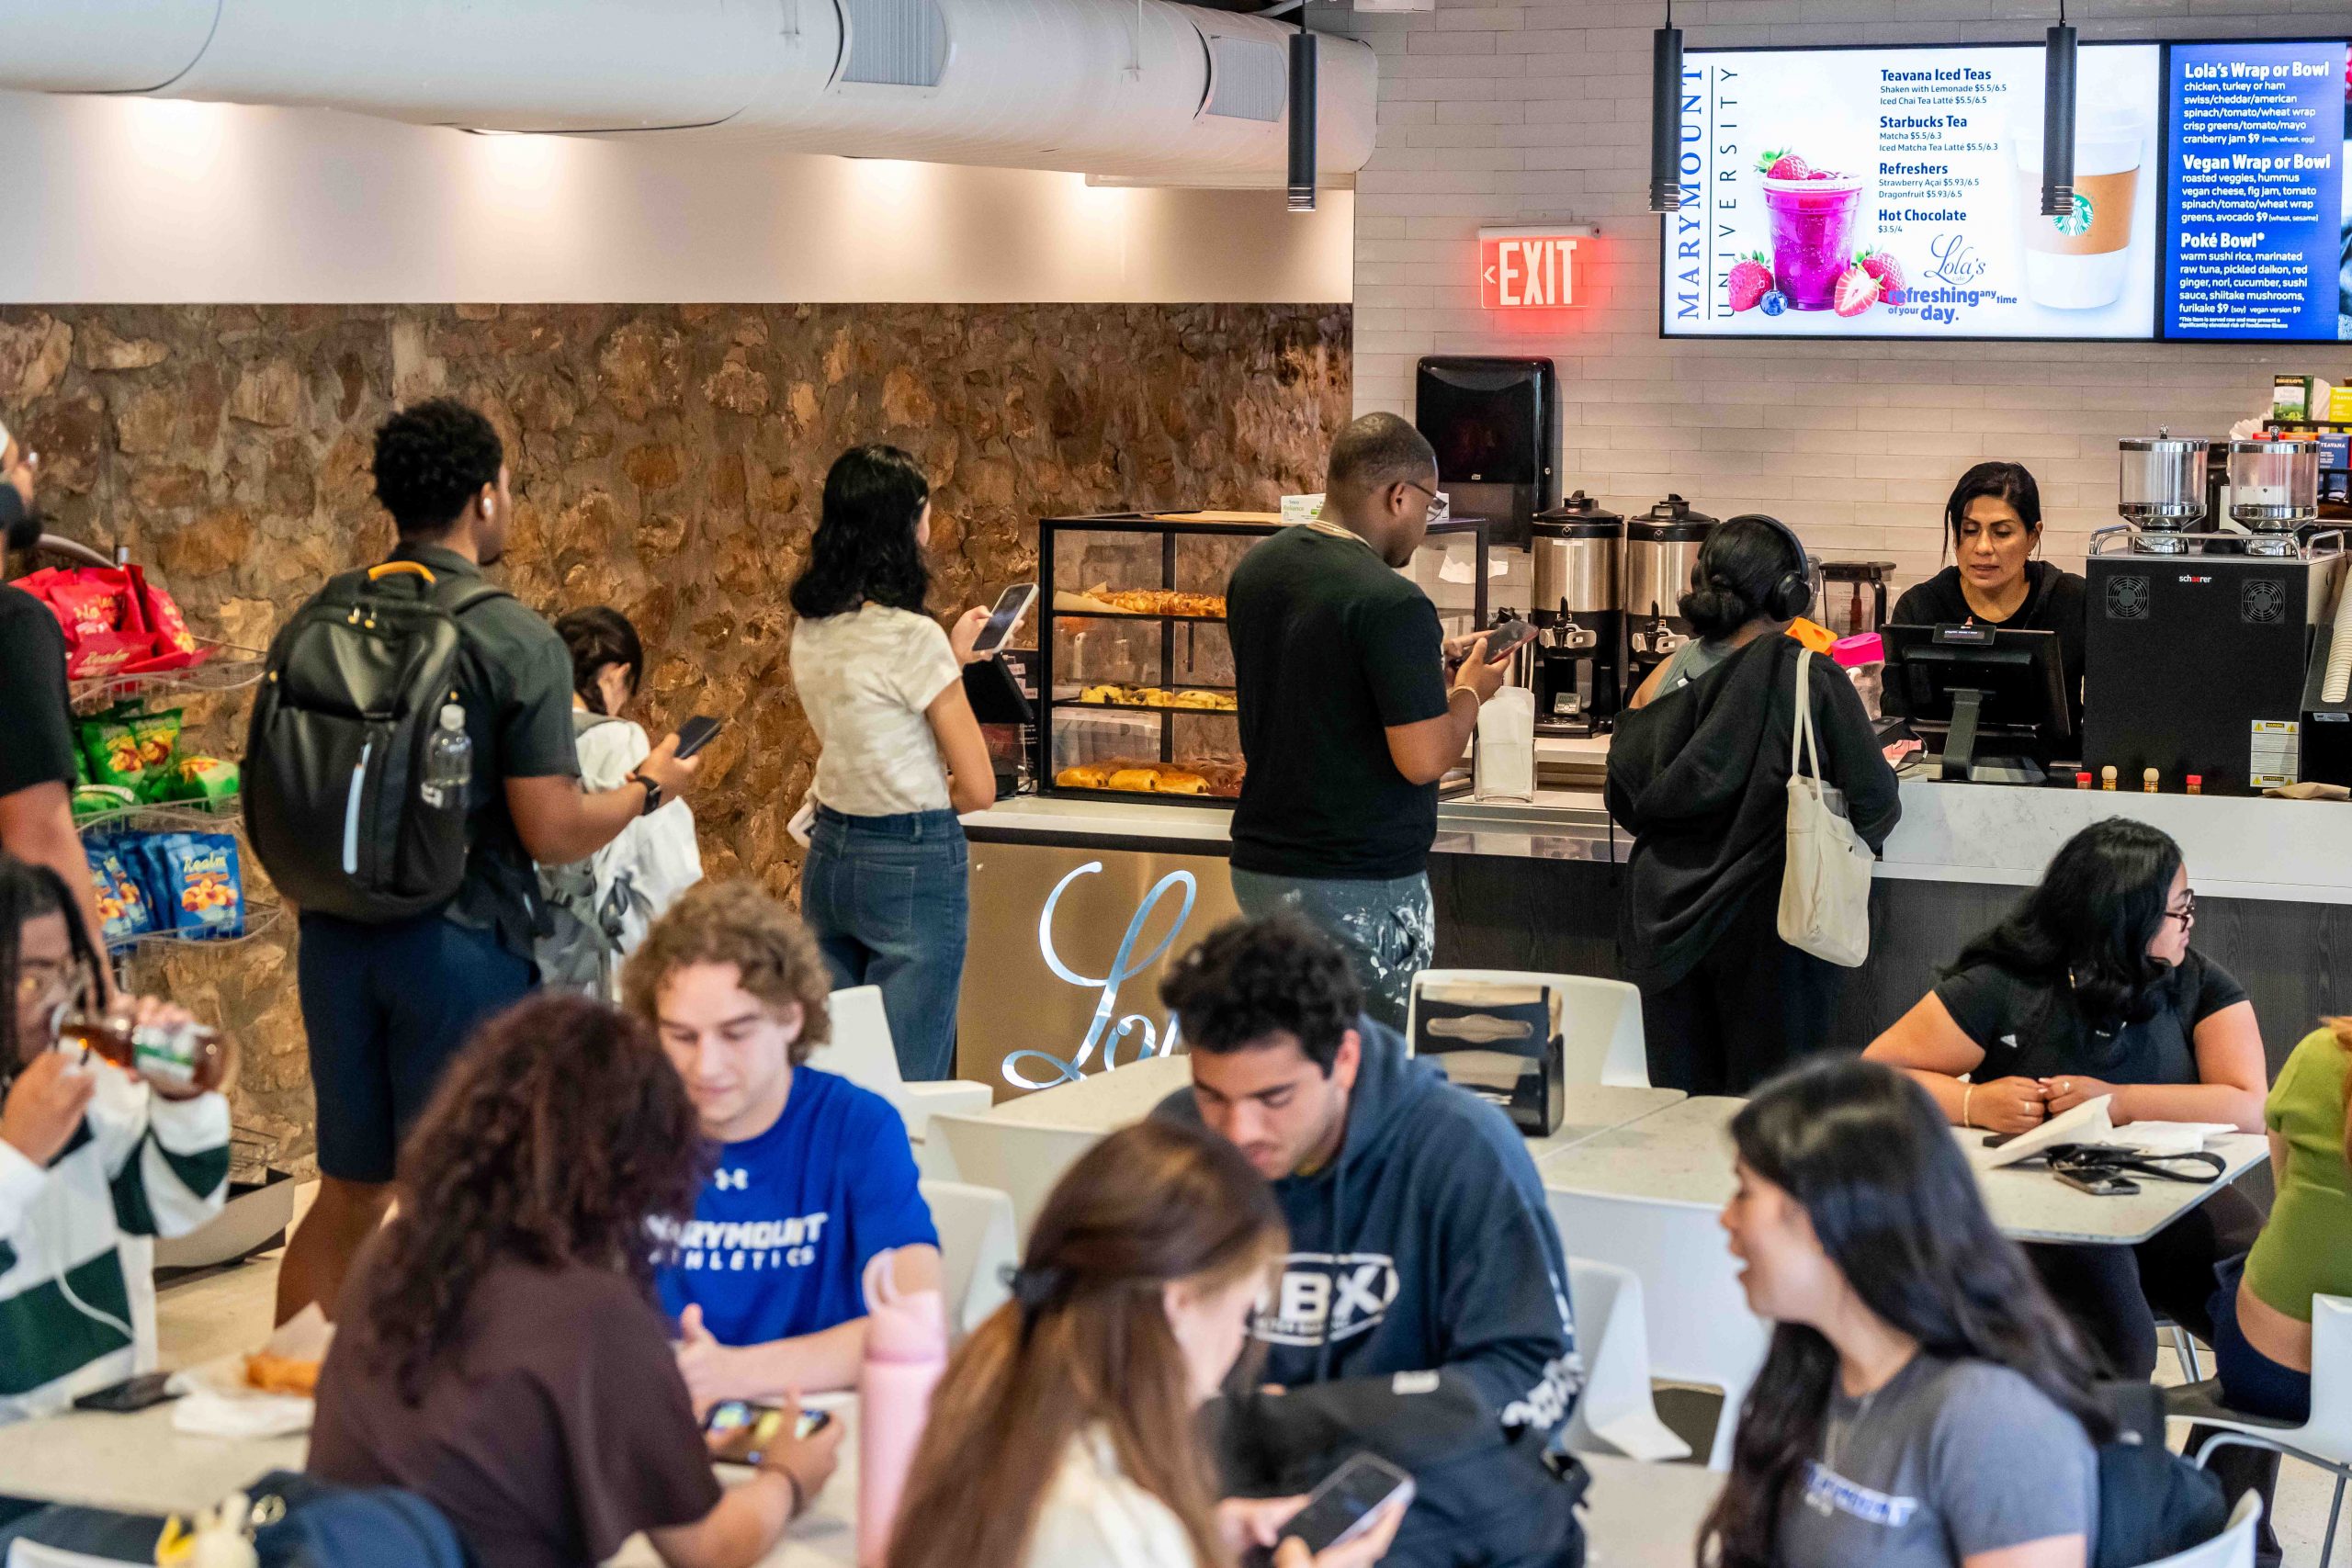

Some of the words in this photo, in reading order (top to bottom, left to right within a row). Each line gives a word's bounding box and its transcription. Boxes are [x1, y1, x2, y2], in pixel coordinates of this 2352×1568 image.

[1881, 70, 1932, 81] Teavana
[1935, 69, 1960, 80] Iced
[1964, 68, 1991, 80] Teas
[2185, 63, 2228, 78] Lola's
[2231, 62, 2270, 81] Wrap
[2273, 65, 2289, 77] or
[2292, 61, 2329, 76] Bowl
[2184, 82, 2221, 92] chicken,
[2223, 82, 2251, 92] turkey
[2265, 82, 2285, 90] ham
[1956, 96, 1987, 105] $5.5/6.5
[2184, 95, 2297, 105] swiss/cheddar/american
[2184, 107, 2290, 118] spinach/tomato/wheat
[2293, 108, 2315, 117] wrap
[1880, 115, 1943, 128] Starbucks
[1946, 115, 1967, 127] Tea
[2183, 122, 2205, 131] crisp
[2207, 121, 2306, 132] greens/tomato/mayo
[1911, 132, 1942, 140] $5.5/6.3
[2183, 135, 2226, 144] cranberry
[2228, 134, 2245, 144] jam
[2248, 133, 2259, 144] $9
[1967, 143, 1998, 151] $5.5/6.3
[1879, 163, 1948, 174] Refreshers
[2183, 154, 2229, 173] Vegan
[2232, 154, 2271, 172] Wrap
[2274, 157, 2291, 169] or
[2294, 153, 2330, 169] Bowl
[1879, 179, 1922, 187] Strawberry
[1944, 178, 1979, 187] $5.93/6.5
[2182, 174, 2216, 182] roasted
[2219, 174, 2256, 184] veggies,
[2258, 174, 2299, 182] hummus
[1678, 65, 1702, 320] MARYMOUNT
[1718, 67, 1738, 317] UNIVERSITY
[1879, 190, 1924, 199] Dragonfruit
[1926, 190, 1962, 198] $5.93/6.5
[2182, 187, 2210, 197] vegan
[2212, 187, 2246, 196] cheese,
[2248, 186, 2259, 197] fig
[2261, 187, 2281, 197] jam,
[2283, 187, 2317, 195] tomato
[2182, 199, 2288, 210] spinach/tomato/wheat
[2290, 201, 2313, 210] wrap
[1879, 209, 1901, 221] Hot
[1905, 209, 1966, 221] Chocolate
[2181, 214, 2215, 223] greens,
[2216, 213, 2254, 221] avocado
[2256, 212, 2268, 222] $9
[2181, 233, 2217, 248] Poké
[1924, 234, 1986, 285] Lola's
[2209, 252, 2233, 260] sushi
[2235, 252, 2253, 262] rice,
[2255, 252, 2302, 260] marinated
[1499, 241, 1577, 305] EXIT
[2199, 265, 2222, 275] tuna,
[2224, 265, 2256, 276] pickled
[2258, 265, 2290, 275] daikon,
[2293, 265, 2307, 273] red
[2180, 278, 2211, 288] ginger,
[2212, 278, 2232, 287] nori,
[2234, 278, 2280, 288] cucumber,
[2283, 278, 2307, 286] sushi
[1889, 287, 1979, 307] refreshing
[2179, 292, 2208, 300] sauce,
[2210, 291, 2244, 300] shiitake
[2247, 291, 2304, 301] mushrooms,
[2179, 304, 2215, 312] furikake
[2217, 303, 2228, 314] $9
[1921, 305, 1959, 324] day.
